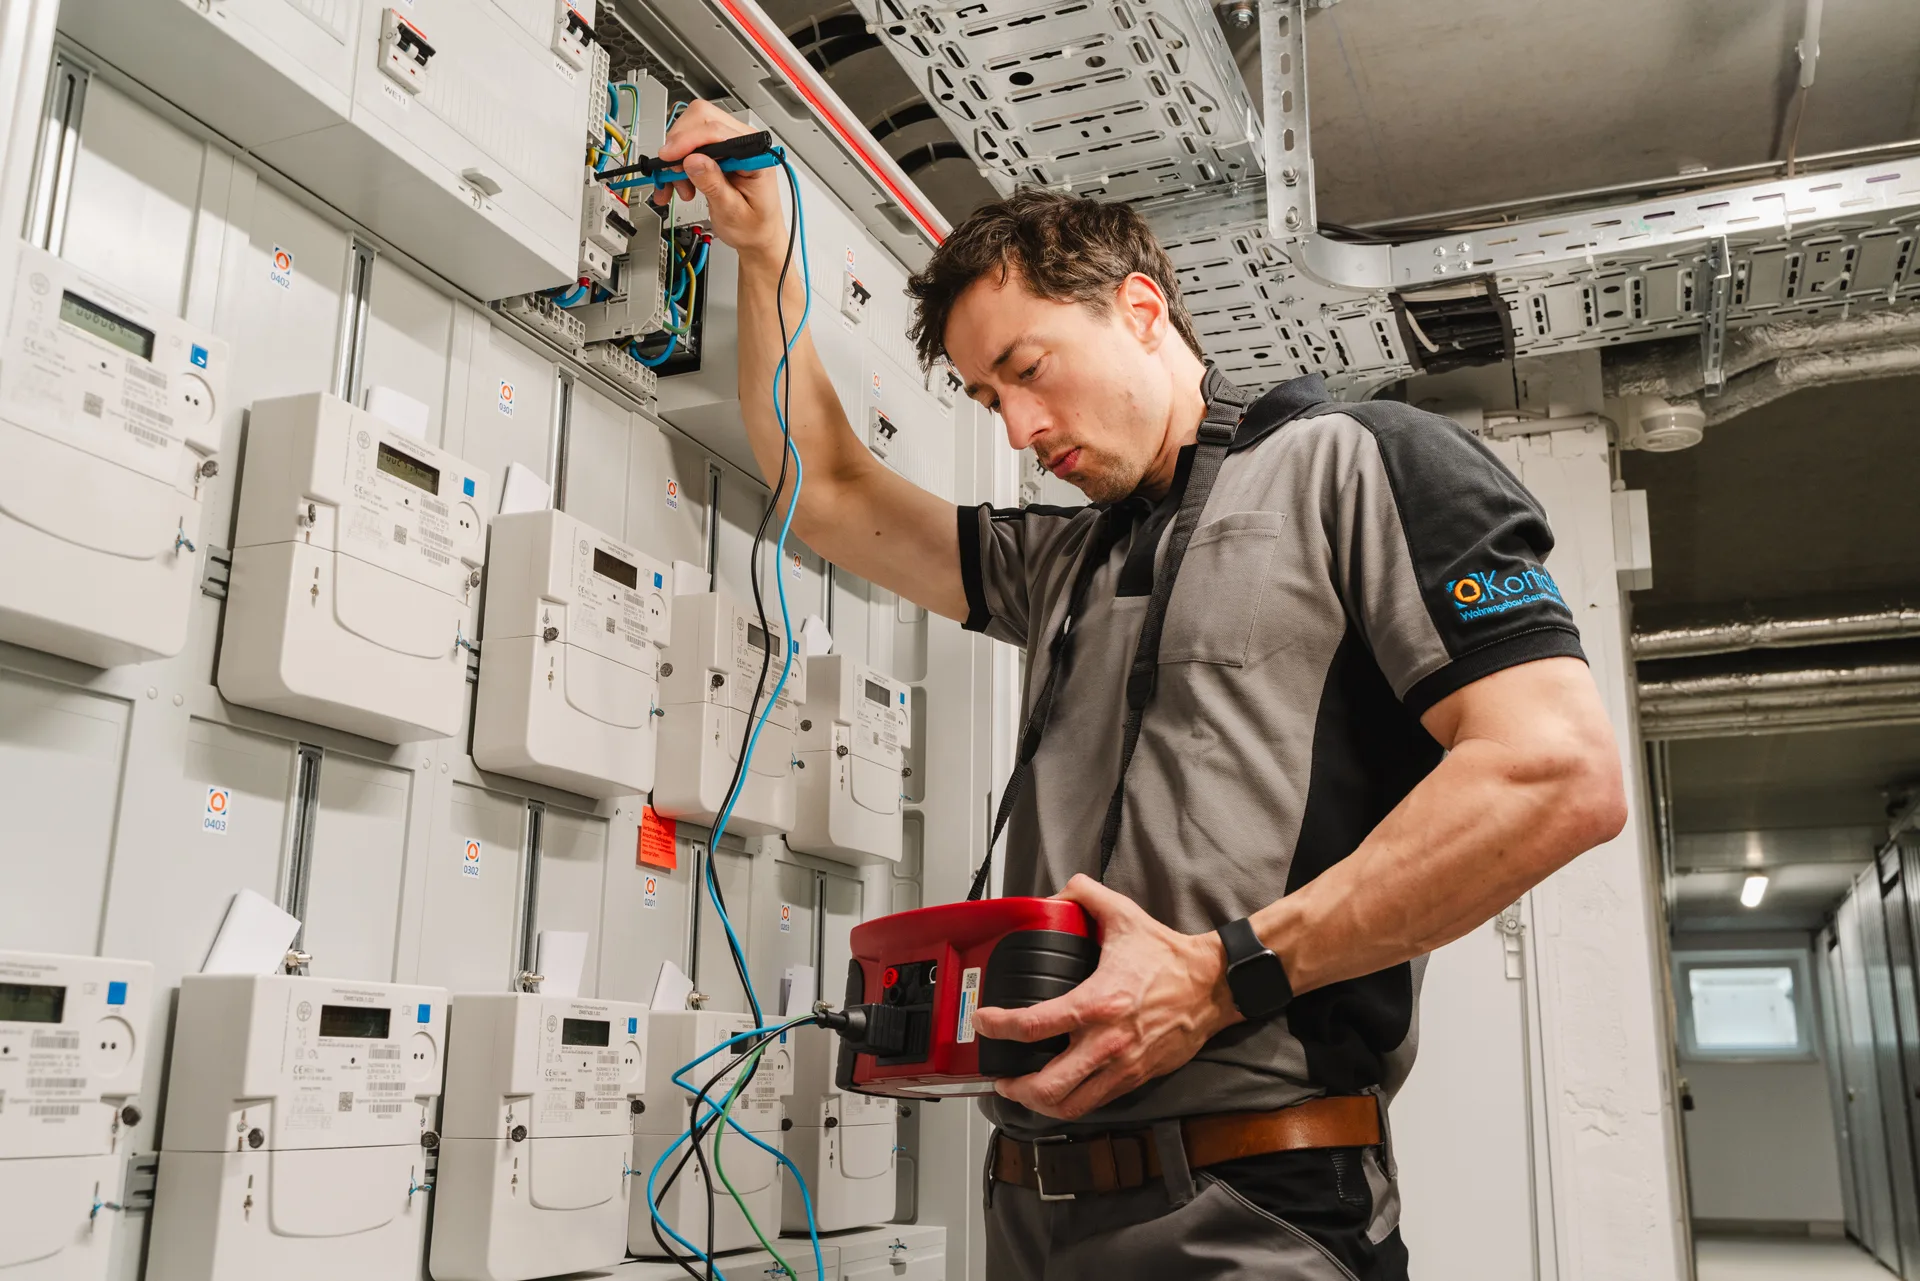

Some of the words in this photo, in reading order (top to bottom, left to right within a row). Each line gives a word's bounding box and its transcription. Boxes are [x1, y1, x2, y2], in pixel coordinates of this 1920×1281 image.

[555, 61, 574, 81] WE10
[384, 83, 407, 106] WE11
[270, 271, 290, 289] 0402
[499, 402, 513, 416] 0301
[666, 497, 677, 509] 0303
[204, 817, 226, 832] 0403
[463, 865, 479, 876] 0302
[644, 897, 656, 908] 0201
